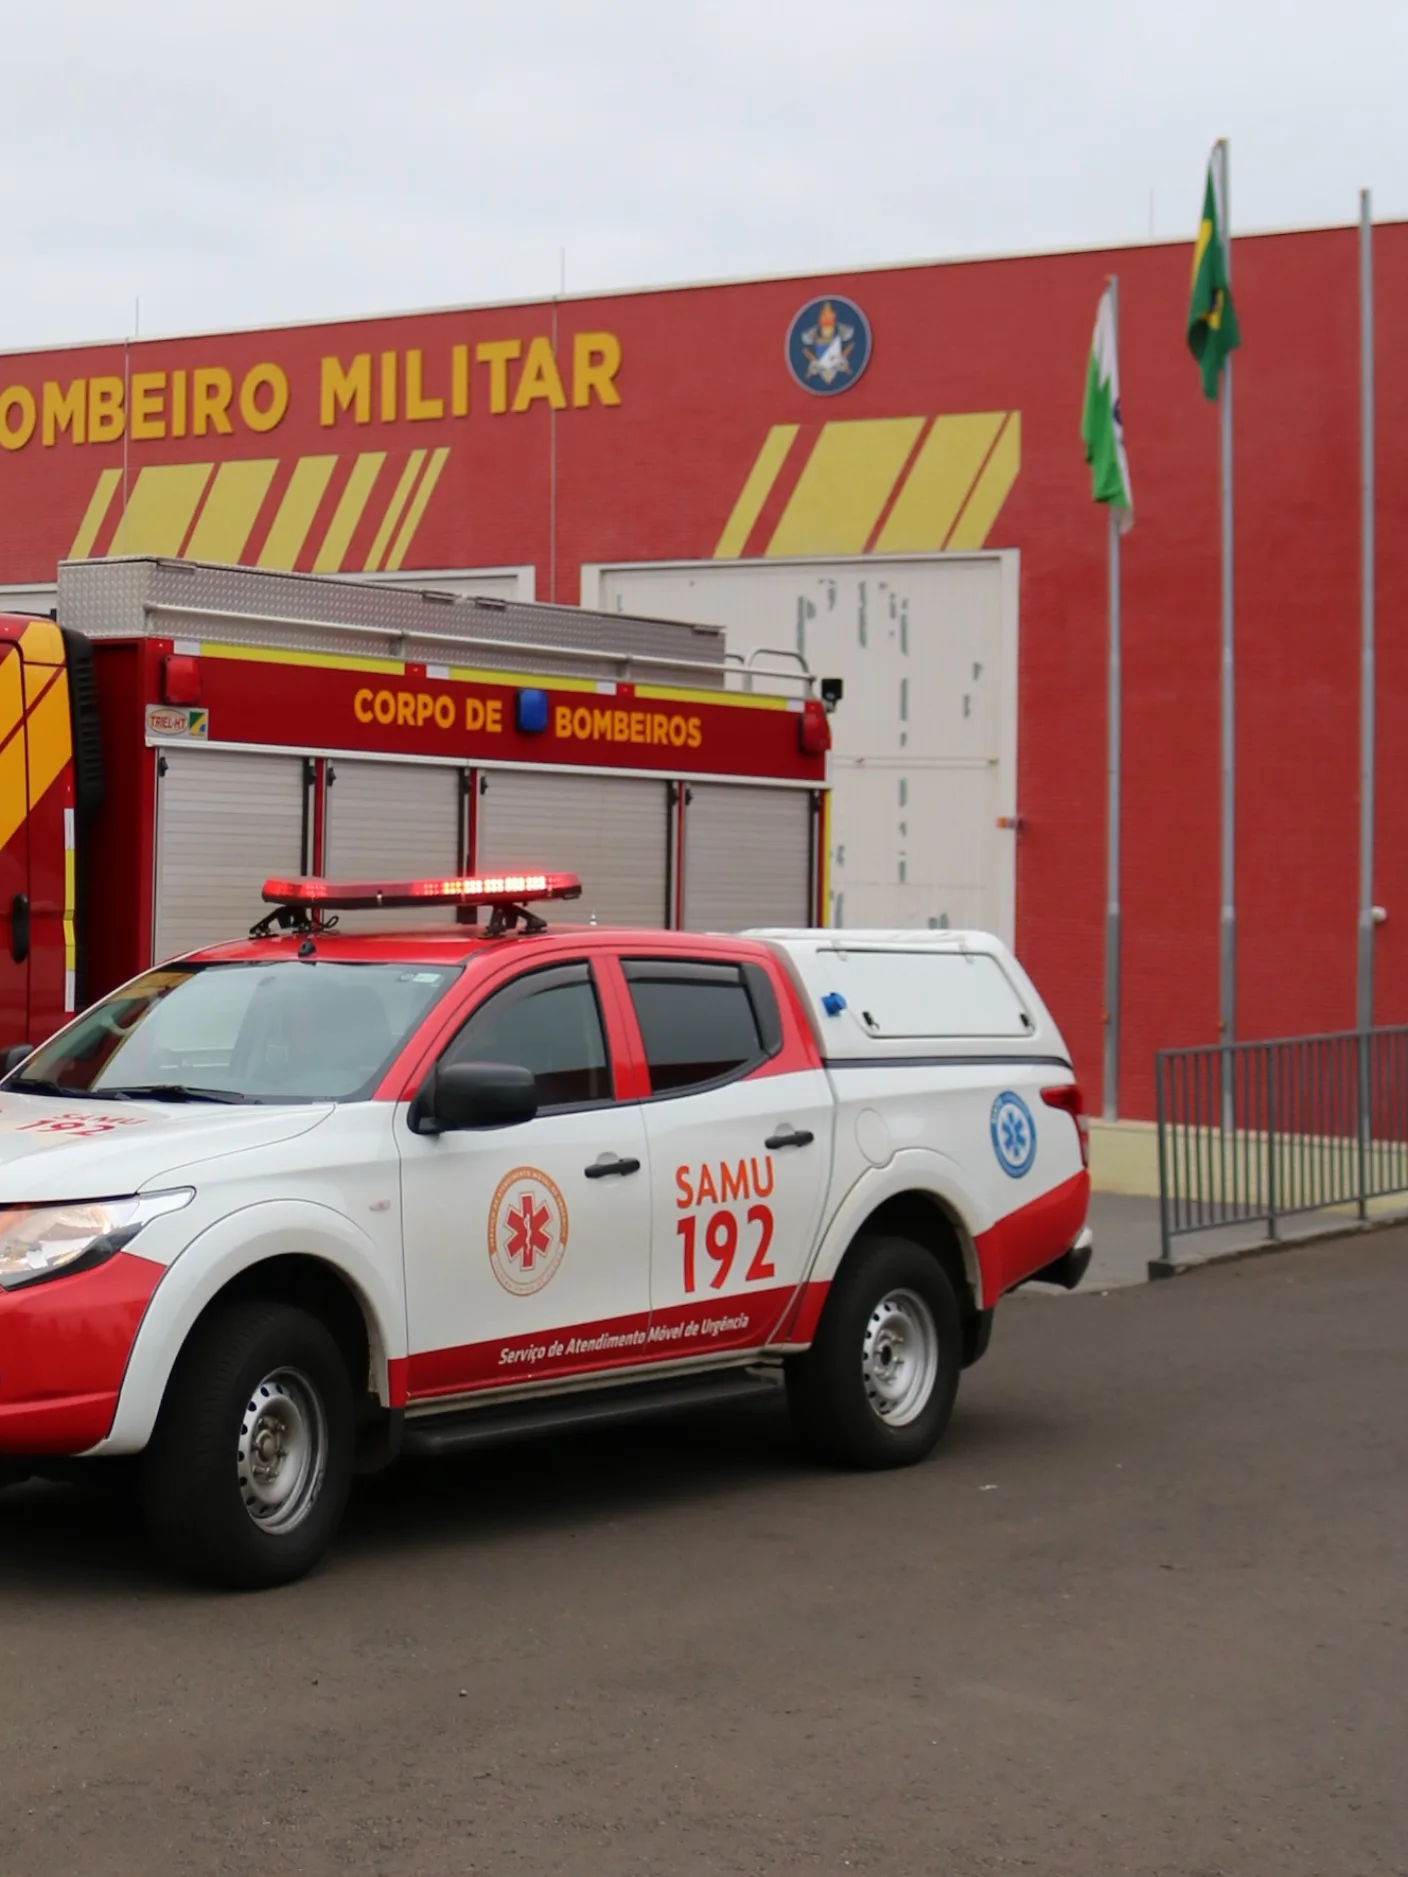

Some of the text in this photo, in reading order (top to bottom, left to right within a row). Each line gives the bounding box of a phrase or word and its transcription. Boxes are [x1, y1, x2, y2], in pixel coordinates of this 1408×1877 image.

[320, 332, 623, 427] MILITAR
[354, 688, 702, 748] CORPO DE BOMBEIROS
[675, 1155, 774, 1209] SAMU
[676, 1204, 775, 1293] 192
[498, 1312, 750, 1365] Serviço de Atendimento Móvel de Urgência
